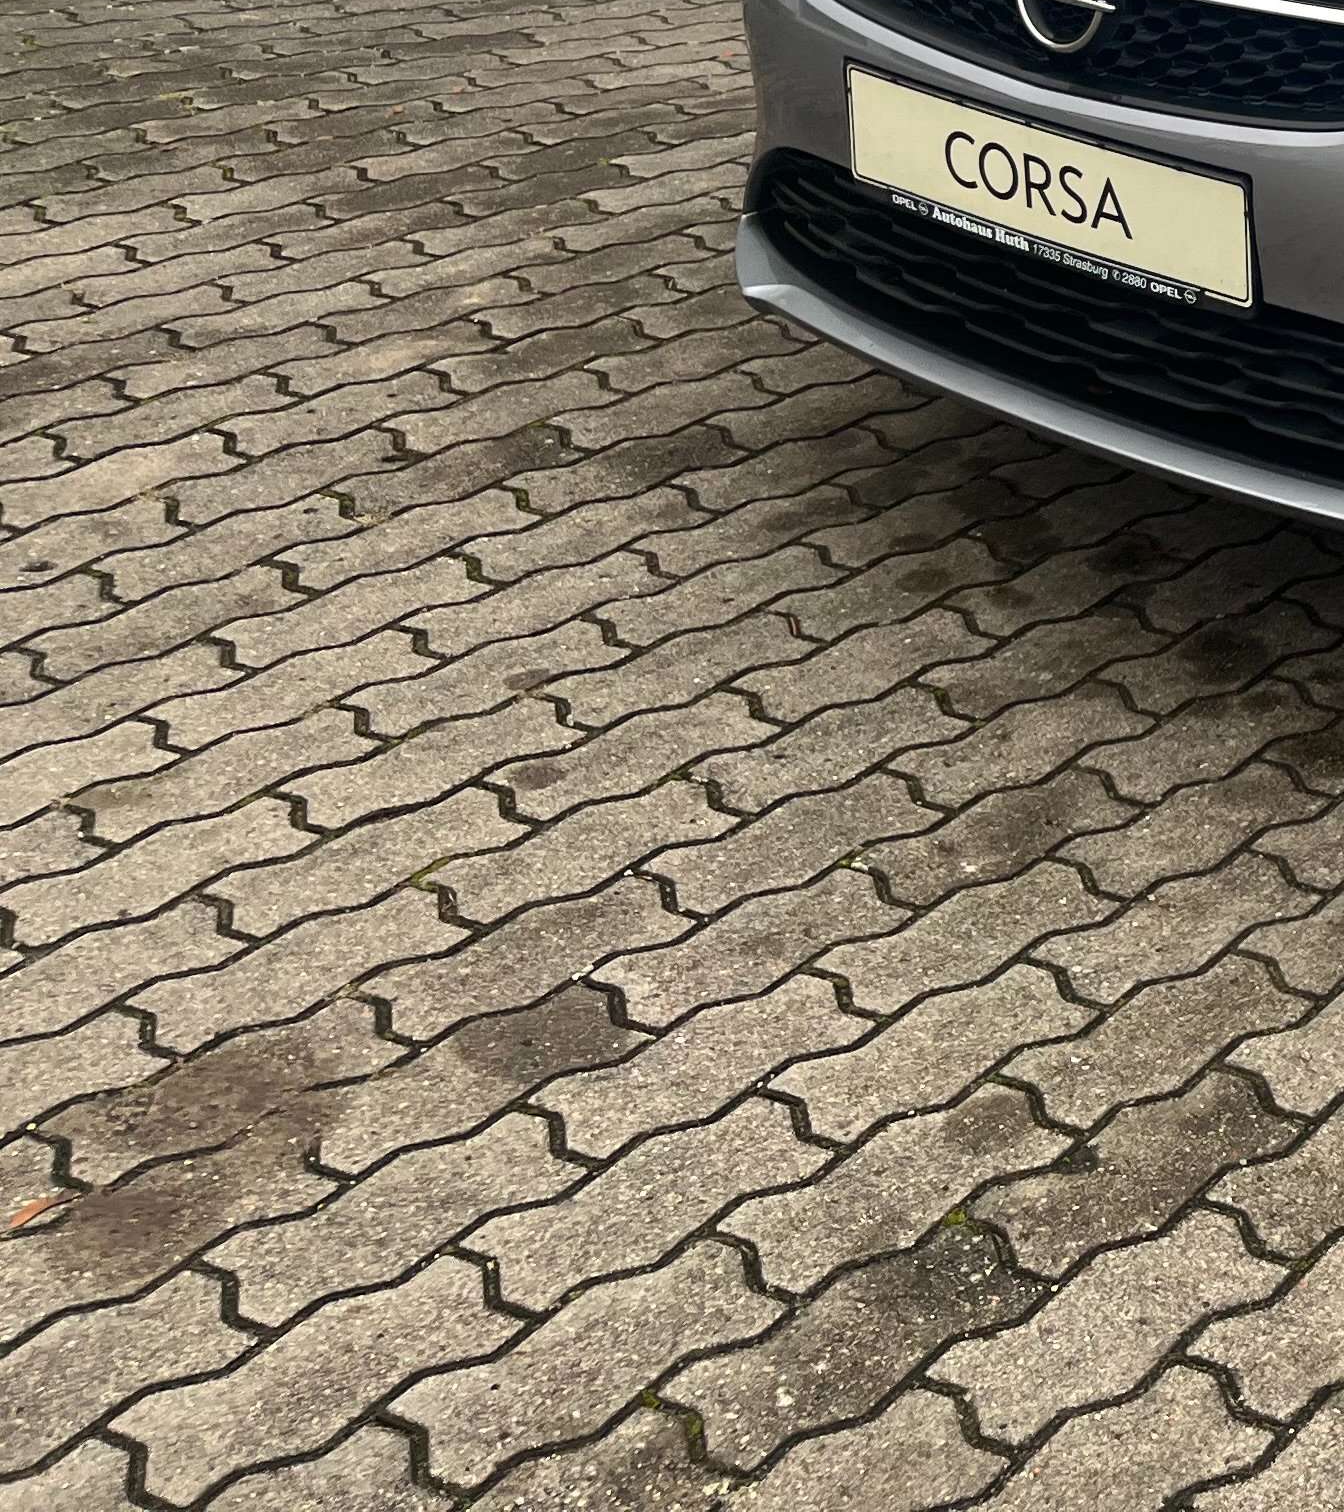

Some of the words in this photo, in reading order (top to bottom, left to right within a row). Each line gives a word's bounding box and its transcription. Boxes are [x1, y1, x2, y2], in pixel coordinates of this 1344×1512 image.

[944, 130, 1133, 240] CORSA
[891, 194, 917, 212] OPEL
[932, 206, 993, 239] Autohaus
[995, 228, 1030, 251] Huth
[1033, 243, 1061, 262] 17335
[1062, 253, 1109, 280] Strasburg
[1150, 282, 1183, 300] OPEL
